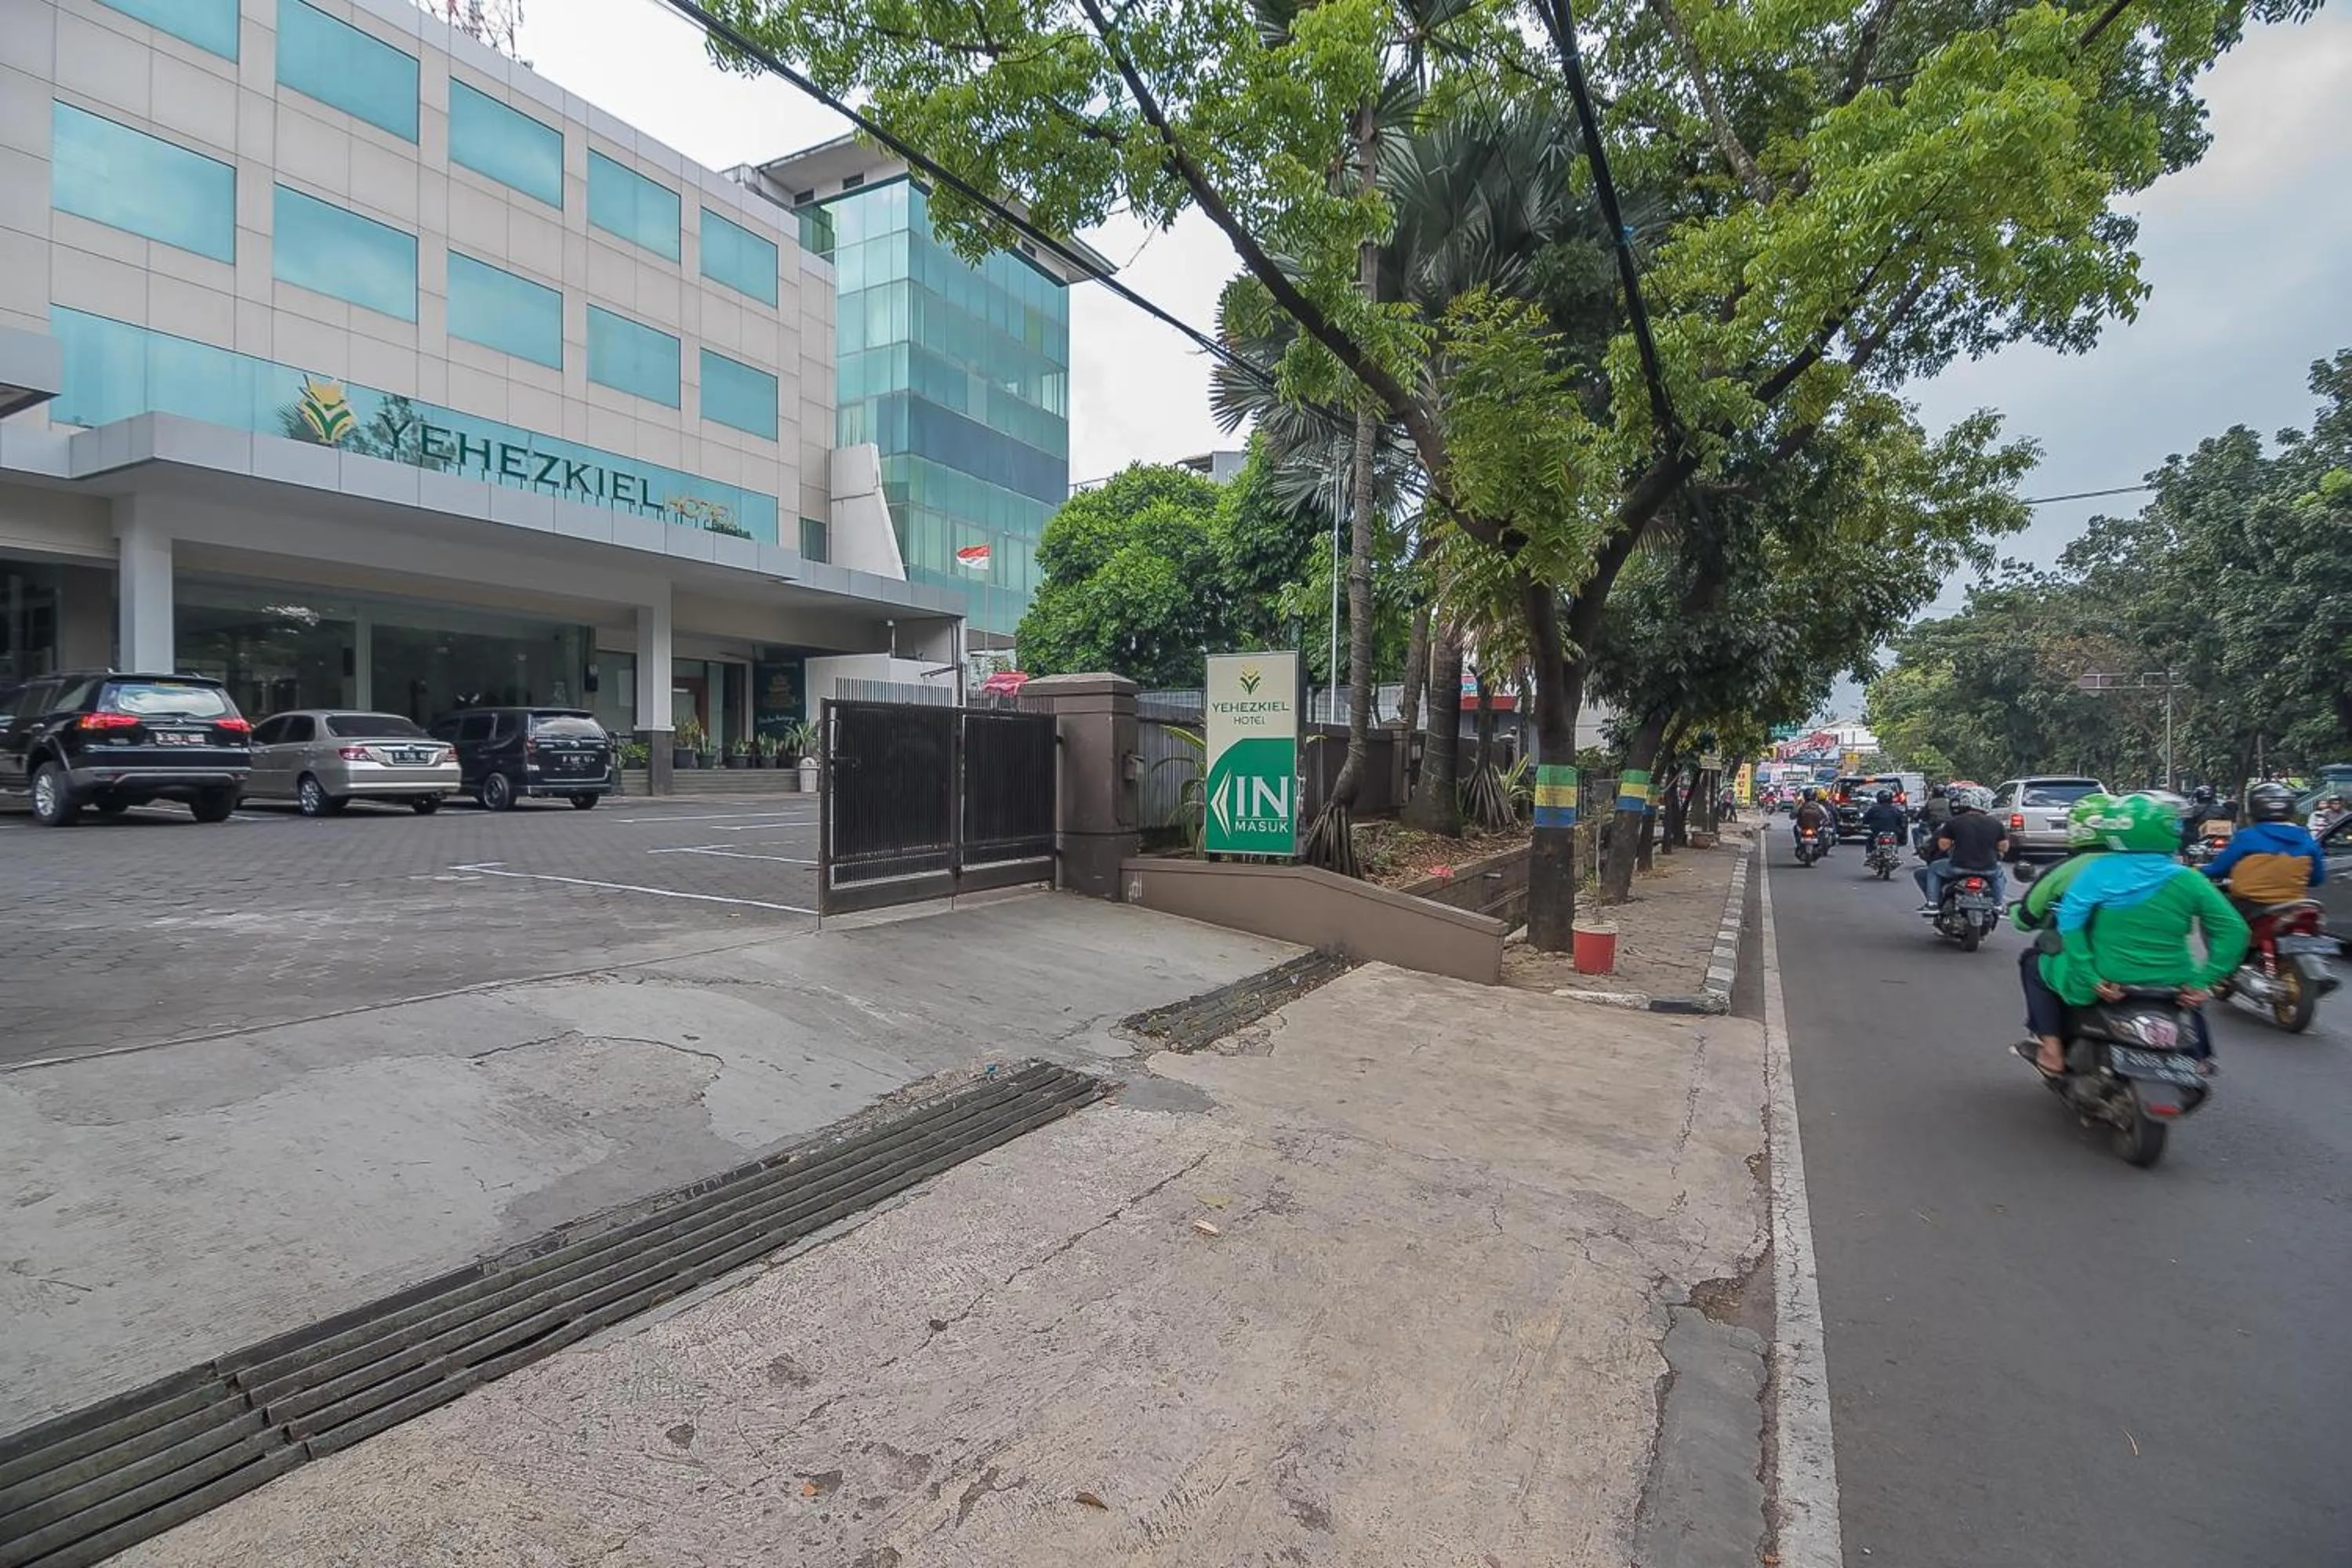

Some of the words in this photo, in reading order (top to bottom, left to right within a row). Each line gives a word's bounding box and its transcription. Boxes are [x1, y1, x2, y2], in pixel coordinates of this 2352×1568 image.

[379, 412, 663, 511] YEHEZKIEL
[1212, 702, 1290, 713] YEHEZKIEL
[1233, 716, 1266, 725] HOTEL
[1236, 775, 1290, 818] IN
[1235, 822, 1289, 834] MASUK
